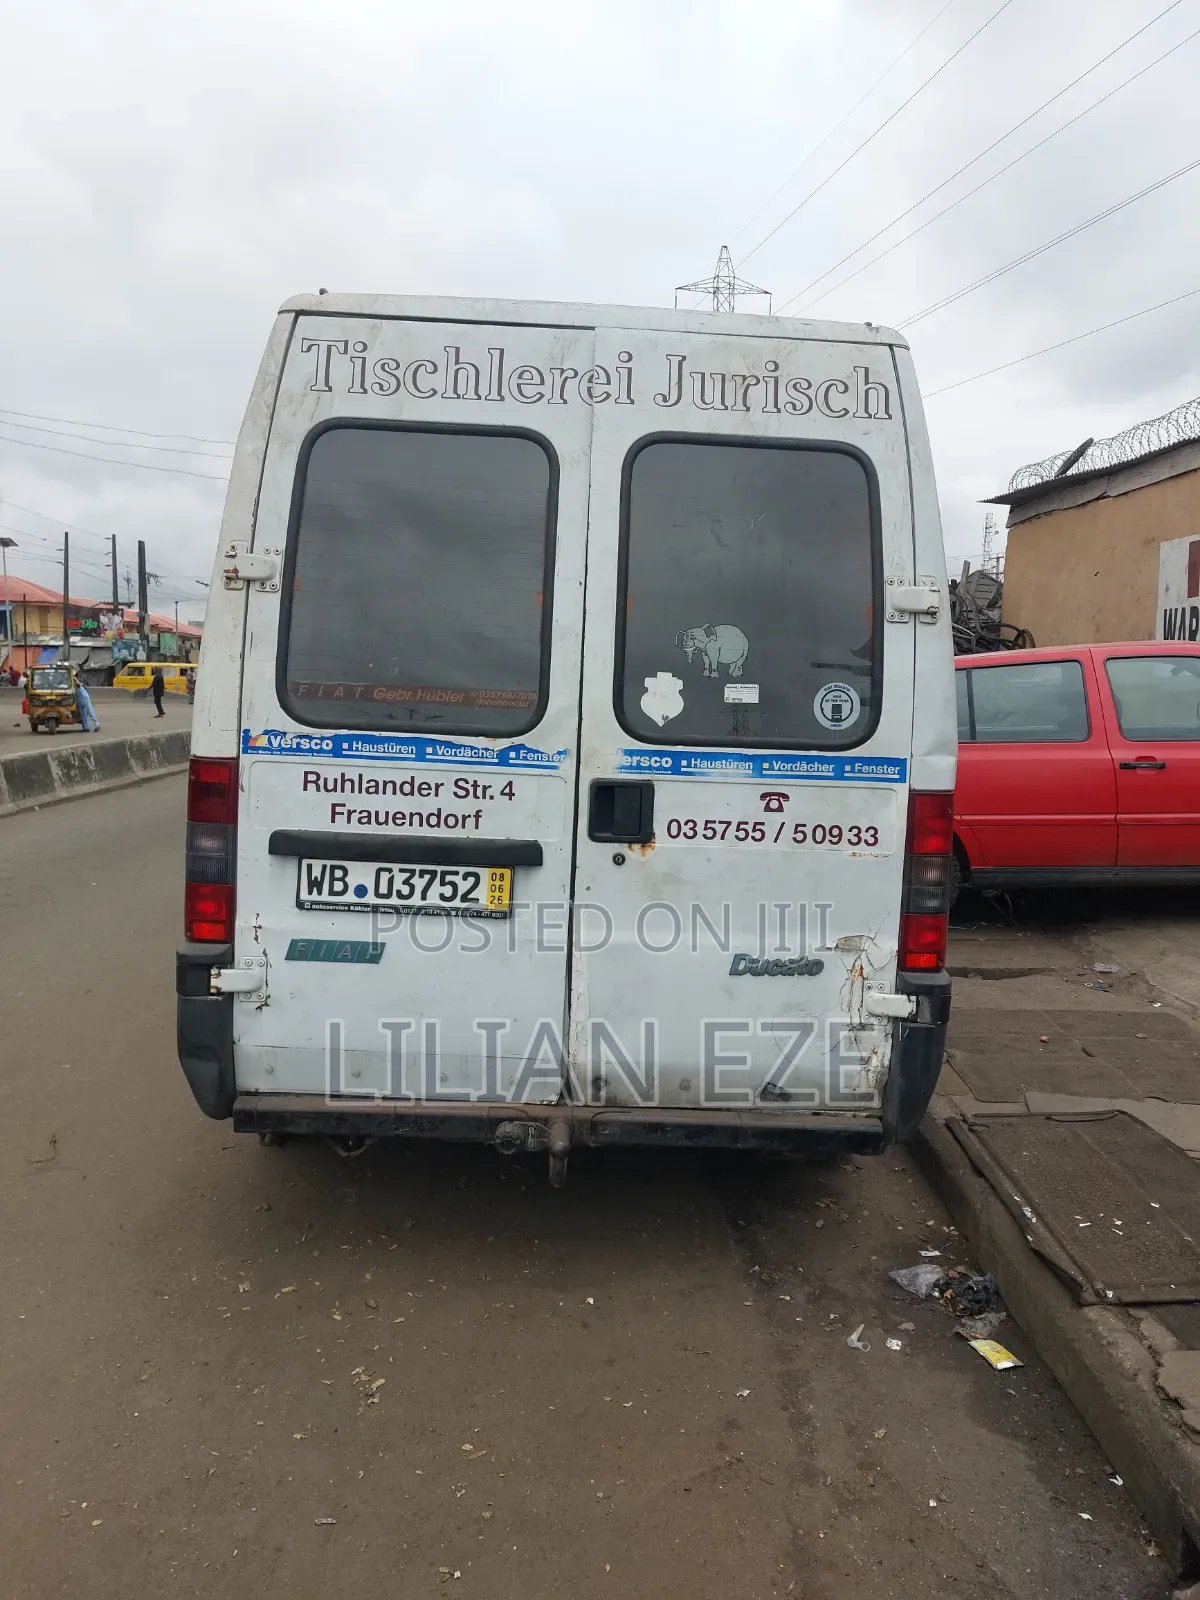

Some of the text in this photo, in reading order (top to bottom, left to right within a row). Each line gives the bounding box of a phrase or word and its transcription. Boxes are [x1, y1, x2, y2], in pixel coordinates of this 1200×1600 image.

[301, 337, 893, 420] Tischlerei Jurisch
[352, 740, 416, 754] Haustüren
[436, 745, 499, 759] Vordächer
[520, 750, 566, 762] Fenster
[691, 757, 753, 770] Haustüren
[773, 760, 835, 772] Vordächer
[855, 762, 900, 775] Fenster
[302, 770, 444, 798] Ruhlander
[330, 803, 483, 830] Frauendorf
[306, 863, 505, 904] WB 03752 08
[490, 883, 504, 894] 06
[489, 895, 504, 905] 26
[294, 941, 379, 960] FIAT
[728, 952, 825, 977] Ducato
